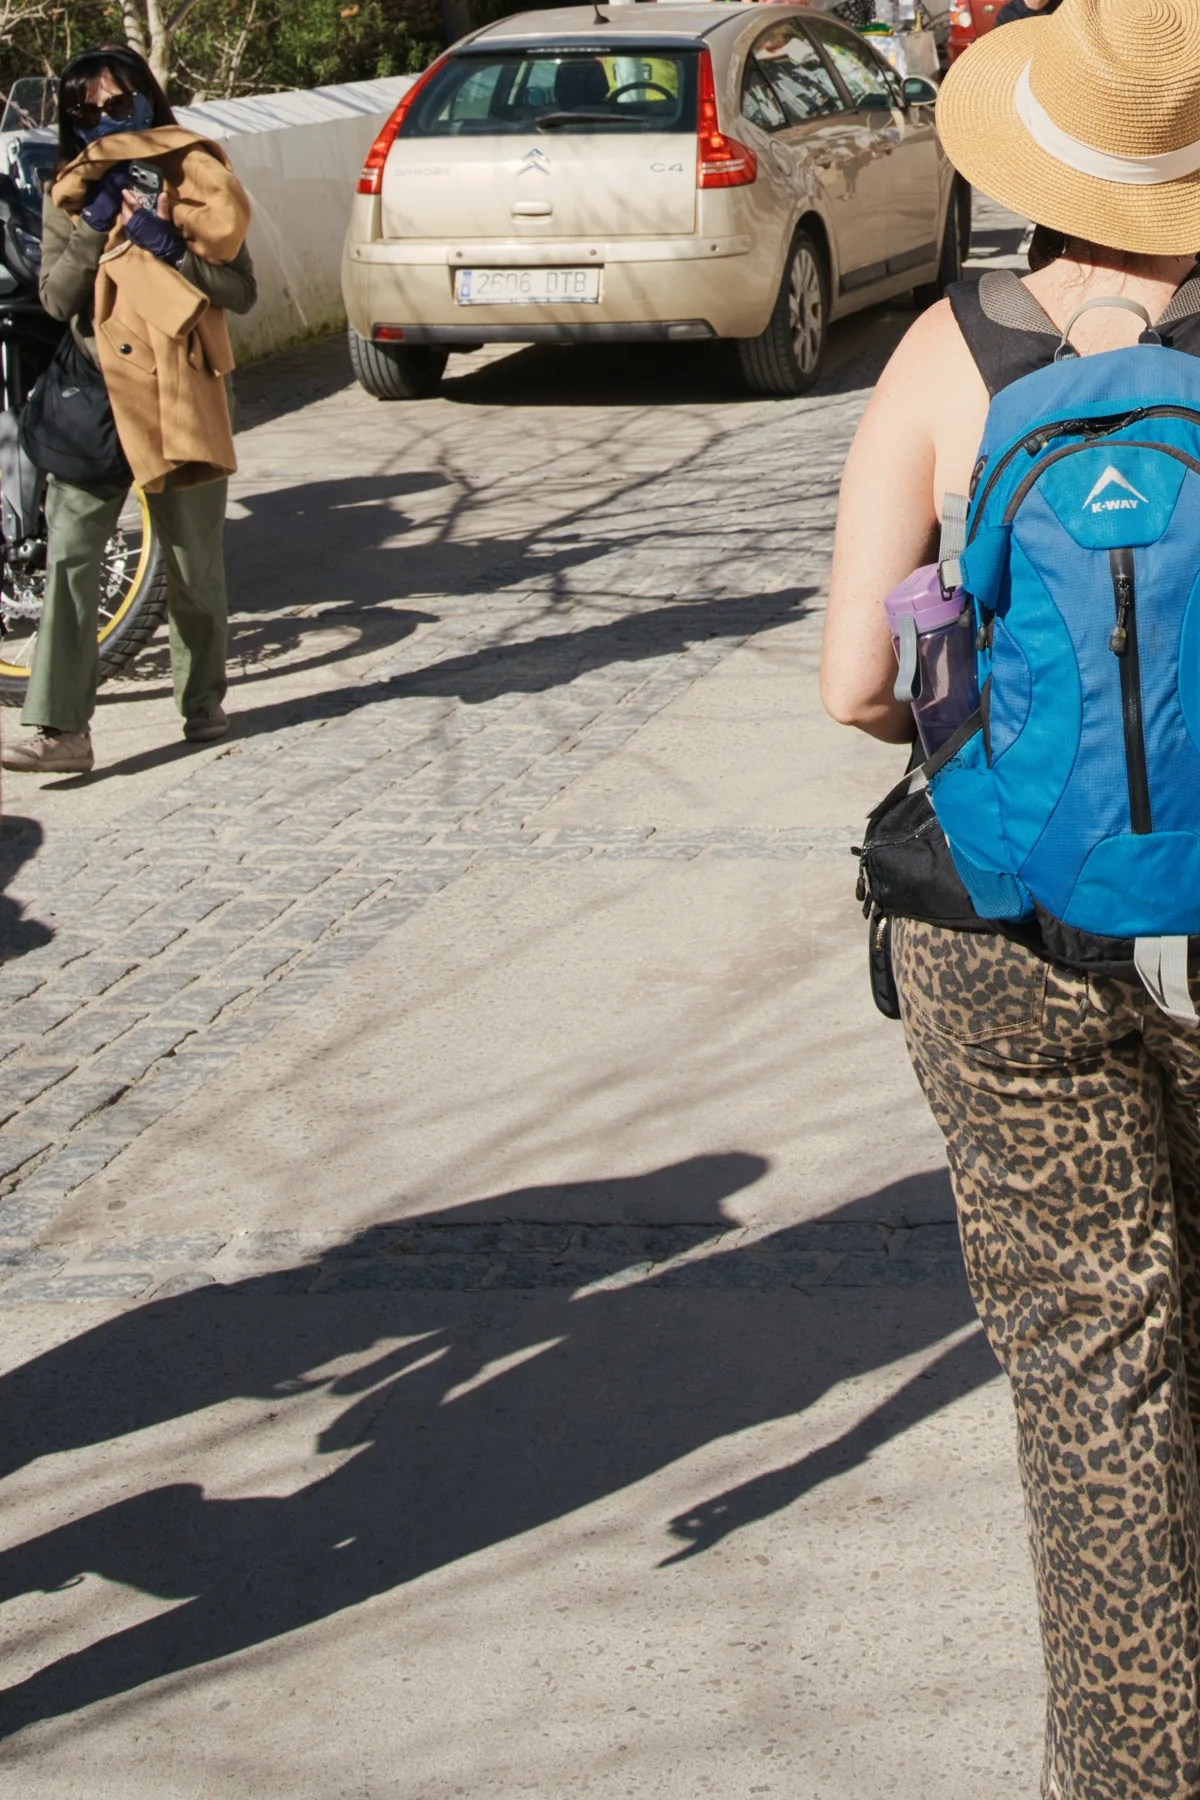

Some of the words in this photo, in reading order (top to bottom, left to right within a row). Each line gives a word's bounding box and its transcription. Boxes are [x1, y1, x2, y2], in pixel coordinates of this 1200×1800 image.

[650, 162, 684, 173] C4
[477, 272, 531, 295] 2606
[545, 272, 587, 293] DTB
[1092, 499, 1138, 513] K-WAY
